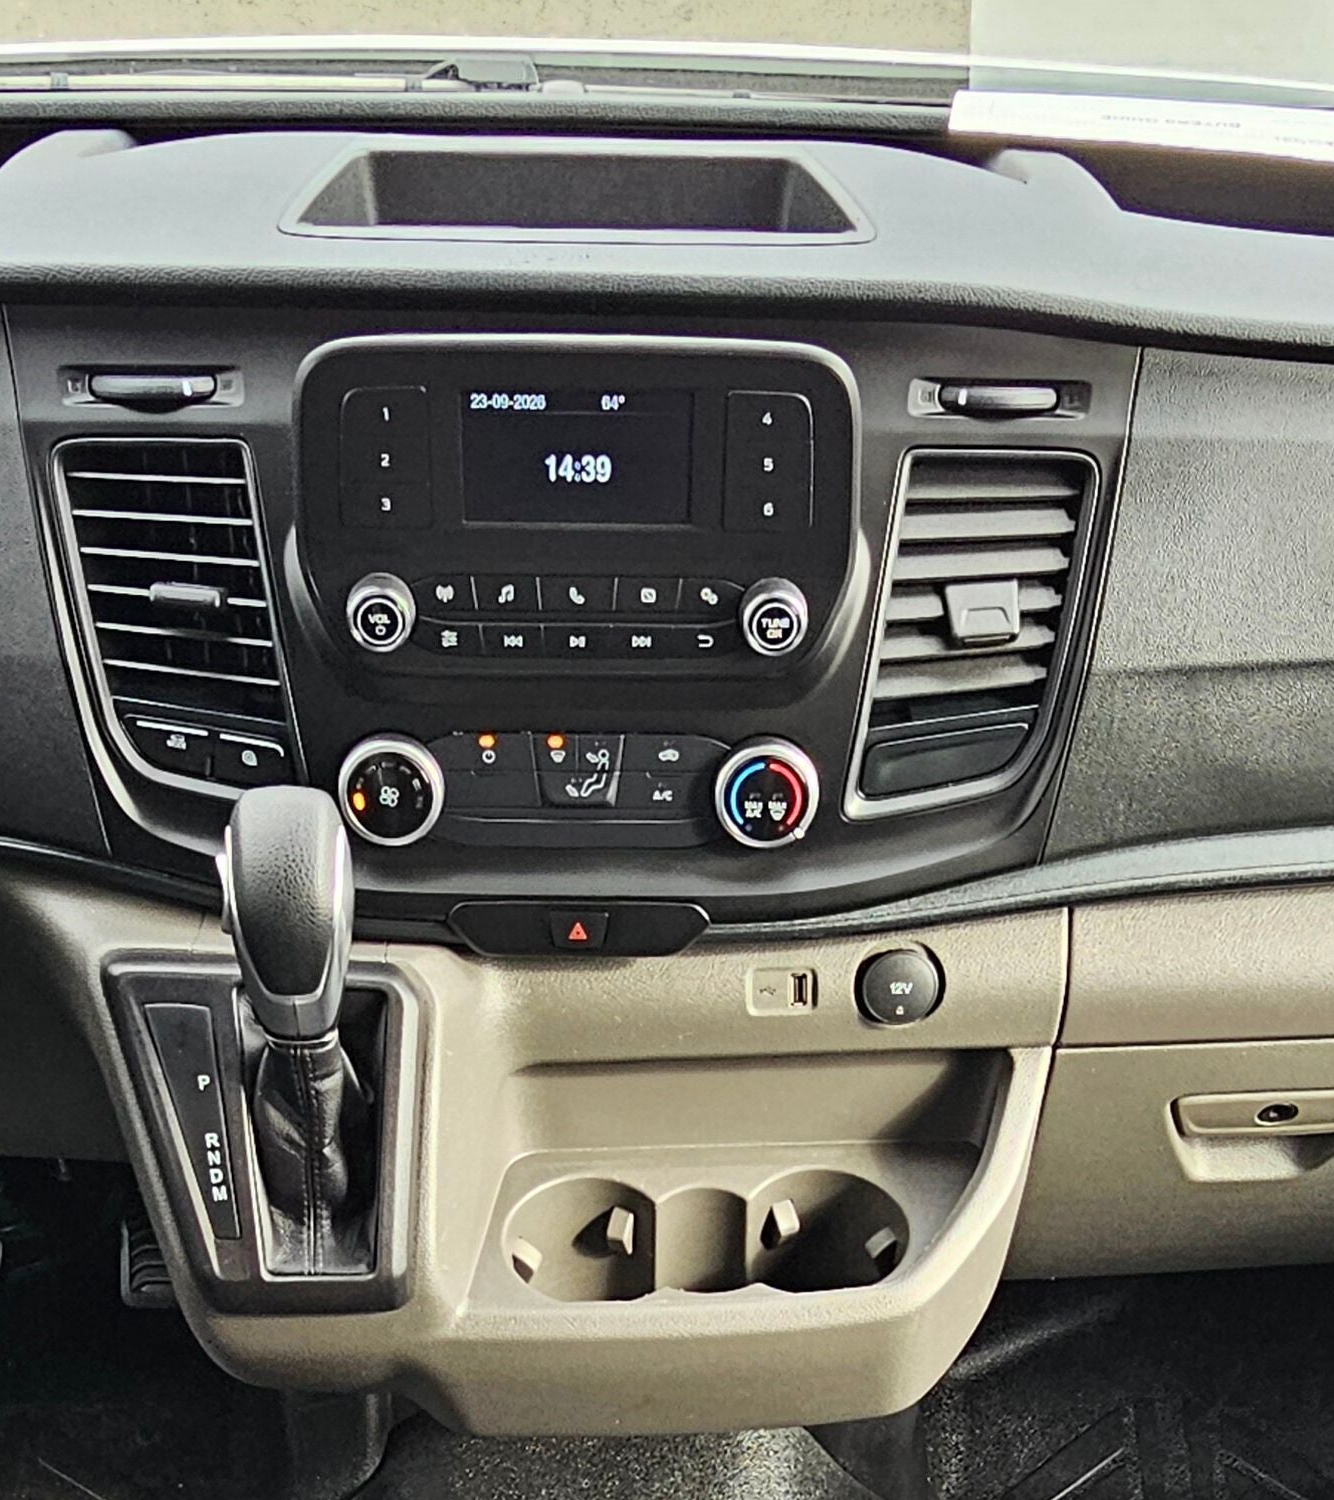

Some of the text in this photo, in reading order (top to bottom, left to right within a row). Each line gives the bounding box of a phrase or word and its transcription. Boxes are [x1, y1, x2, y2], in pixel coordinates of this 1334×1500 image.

[382, 406, 390, 421] 1
[762, 411, 773, 425] 4
[380, 453, 390, 467] 2
[763, 457, 774, 472] 5
[544, 453, 612, 483] 14:39
[380, 497, 391, 511] 3
[763, 502, 774, 516] 6
[367, 613, 391, 624] VOL
[652, 790, 673, 801] A/C
[889, 981, 914, 995] 12V
[197, 1075, 210, 1090] P
[205, 1133, 220, 1148] R
[207, 1151, 221, 1166] N
[210, 1169, 224, 1184] D
[212, 1187, 228, 1202] M
